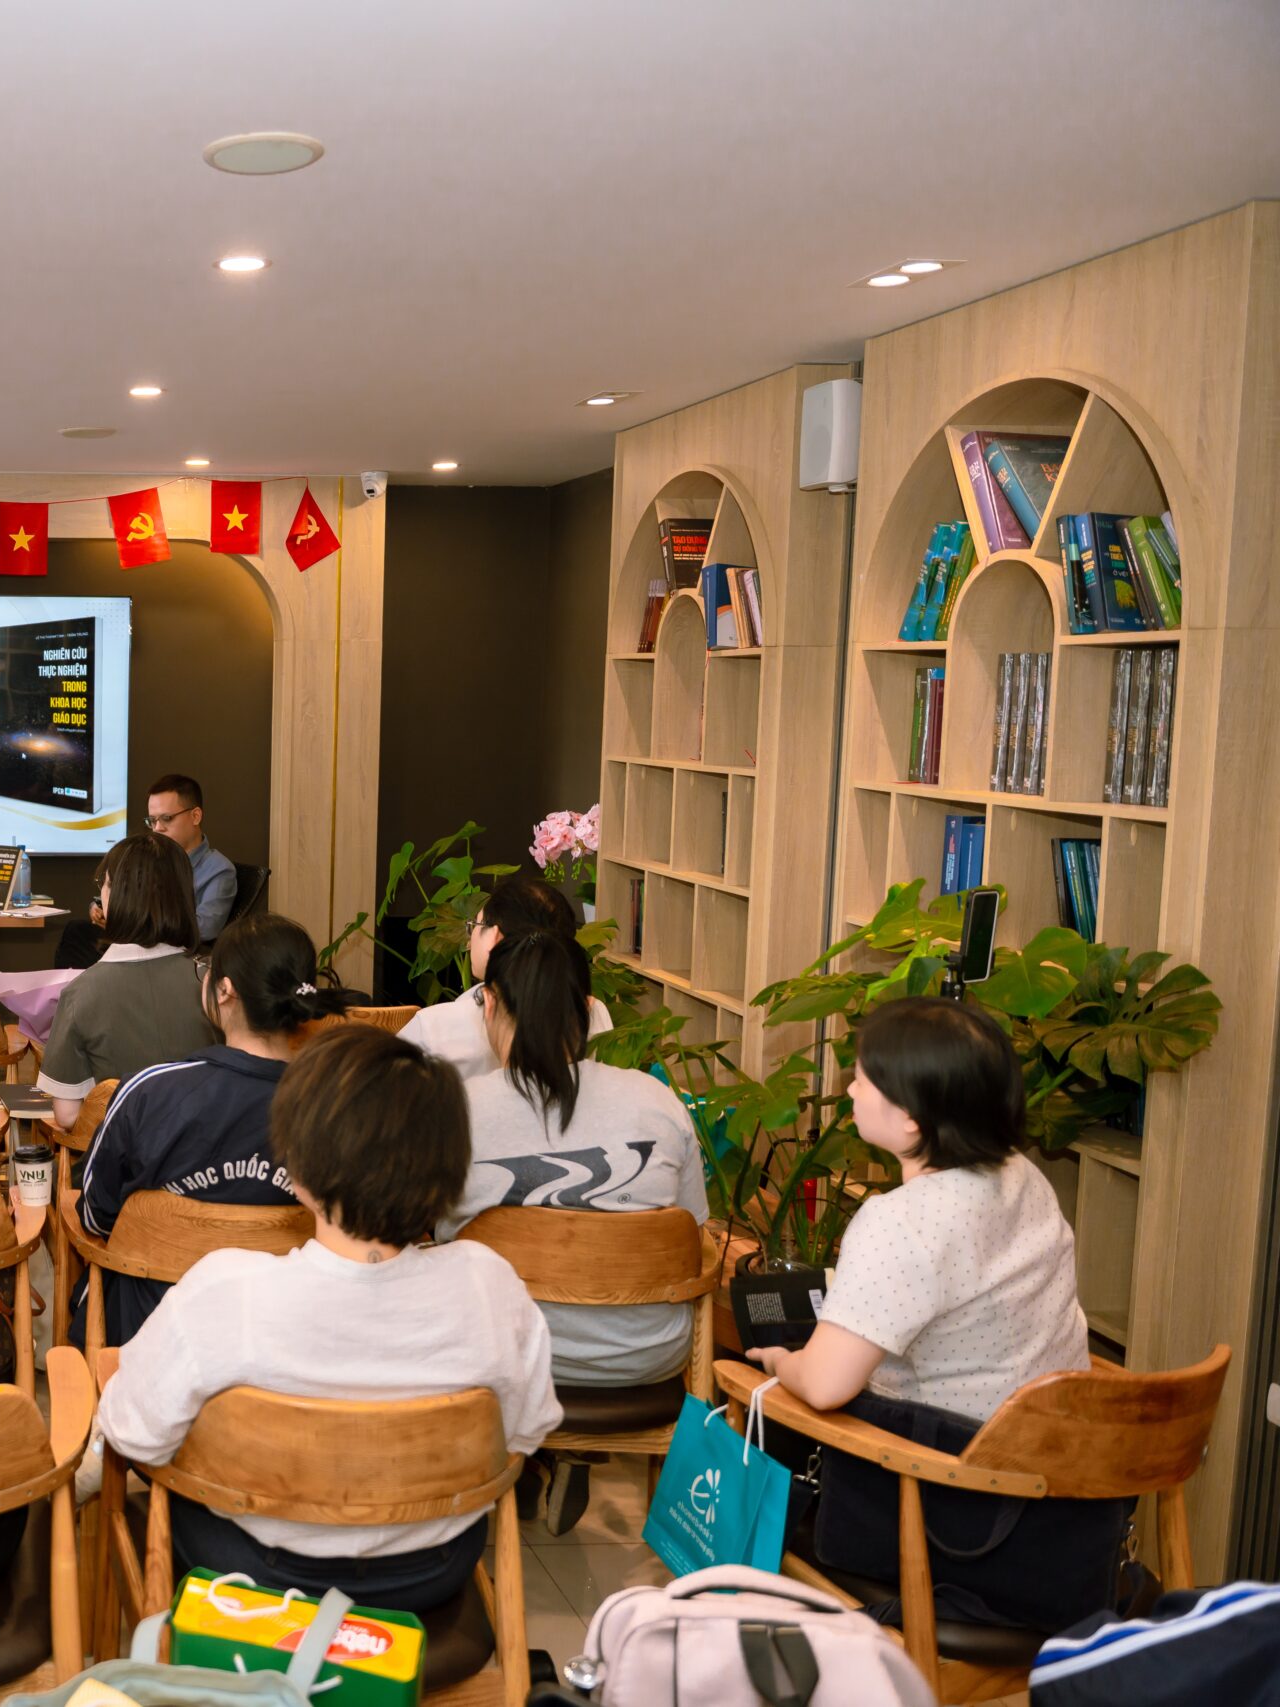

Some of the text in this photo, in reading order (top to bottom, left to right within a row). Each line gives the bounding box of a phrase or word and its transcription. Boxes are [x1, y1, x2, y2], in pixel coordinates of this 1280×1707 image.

[43, 645, 88, 661] NGHIÊN CỨU
[38, 663, 87, 679] THỰC NGHIỆM
[62, 681, 87, 693] TRONG
[50, 696, 87, 711] KHOA HỌC
[52, 711, 87, 727] GIÁO DỤC
[19, 1169, 45, 1180] VNU
[182, 1166, 220, 1189] HỌC
[223, 1152, 271, 1181] QUỐC
